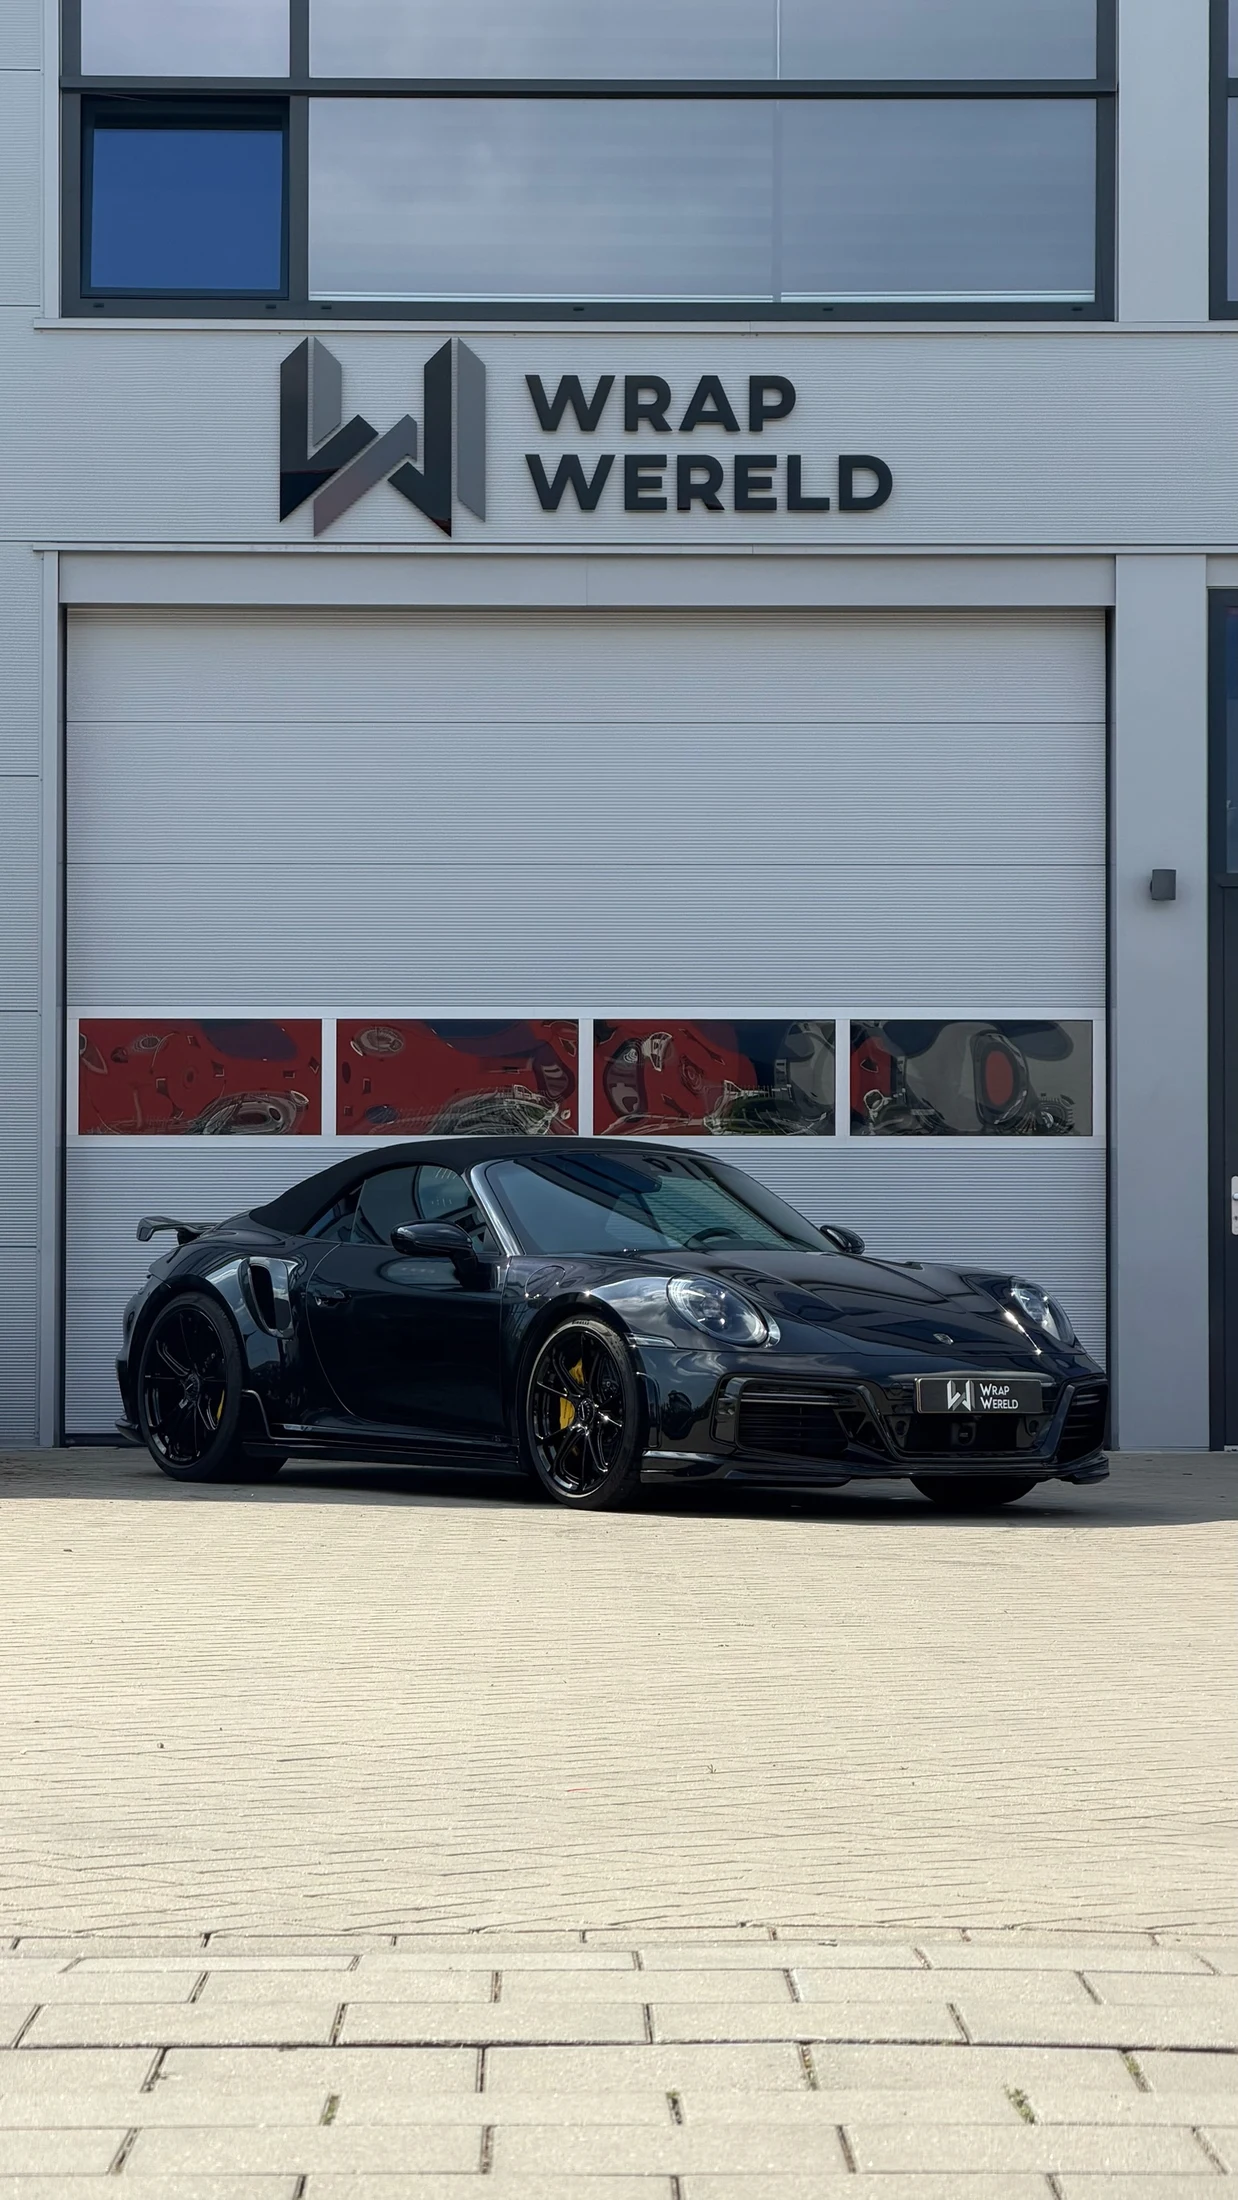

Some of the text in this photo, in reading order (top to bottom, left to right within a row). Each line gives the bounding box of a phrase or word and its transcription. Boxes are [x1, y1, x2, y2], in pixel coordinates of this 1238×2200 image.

[525, 374, 796, 432] WRAP
[525, 454, 894, 511] WERELD
[979, 1383, 1010, 1396] WRAP
[979, 1397, 1019, 1409] WERELD
